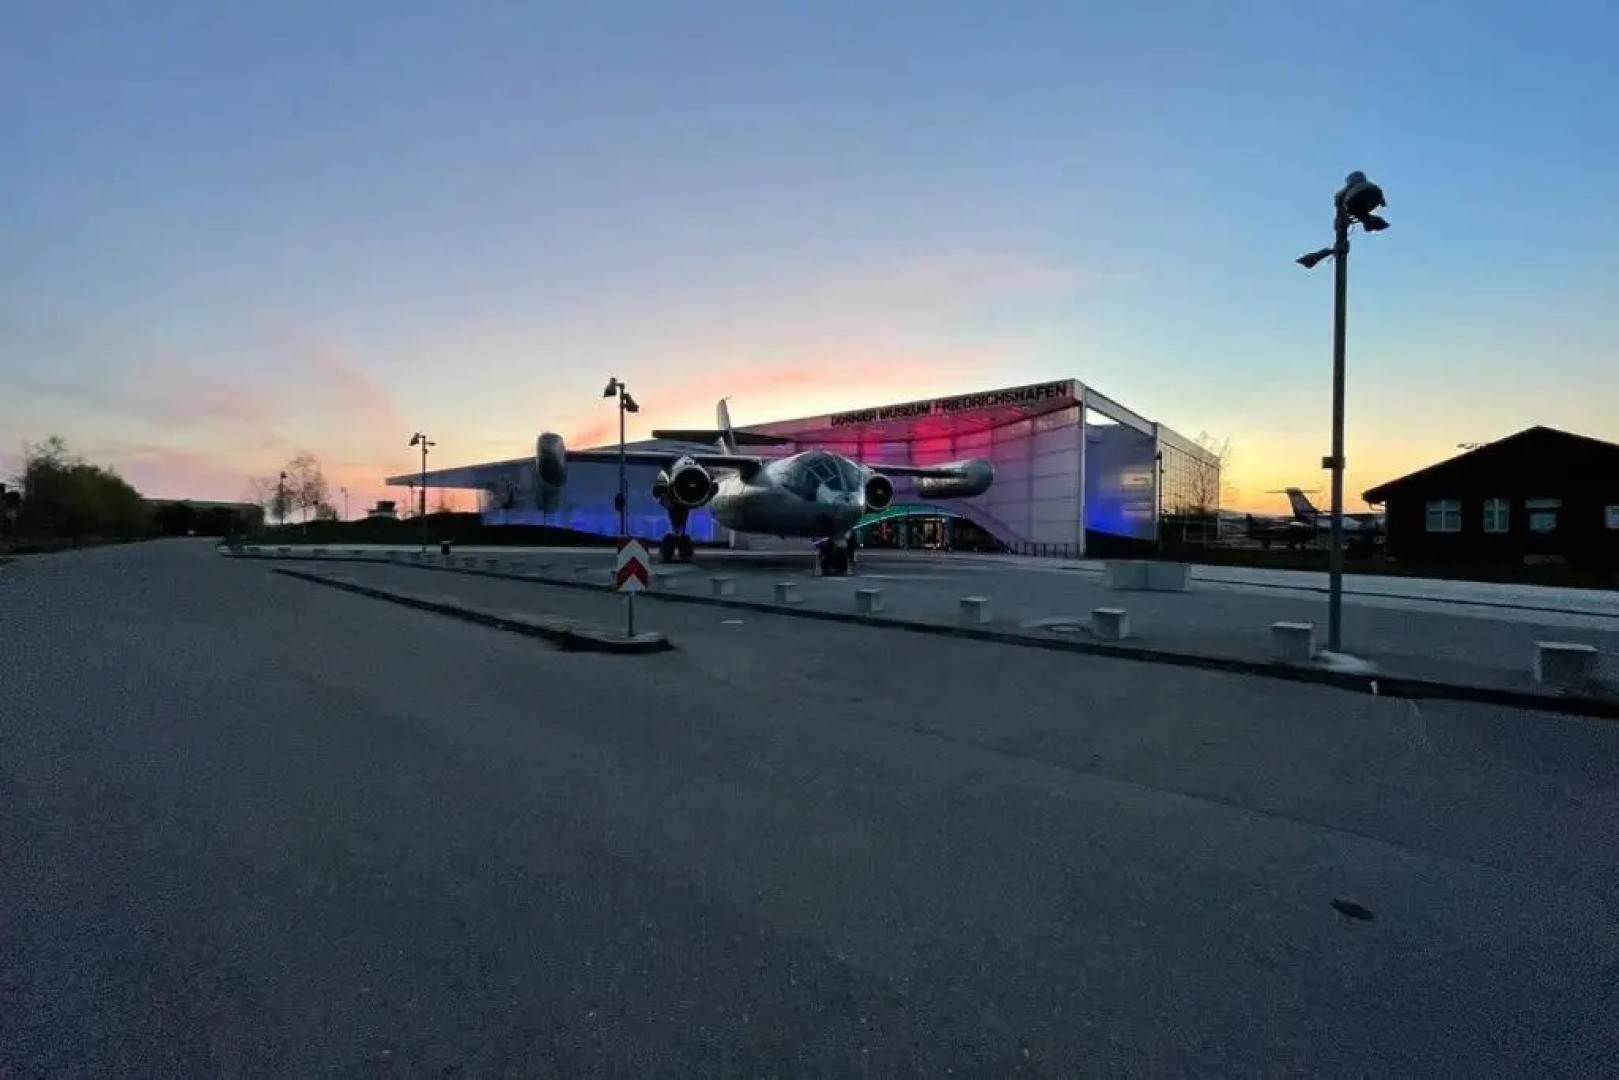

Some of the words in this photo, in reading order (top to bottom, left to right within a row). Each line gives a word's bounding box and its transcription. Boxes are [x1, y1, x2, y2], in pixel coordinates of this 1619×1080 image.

[831, 410, 879, 426] DORNIER
[880, 403, 930, 419] MUSEUM
[935, 382, 1067, 412] FRIEDRICHSHAFEN
